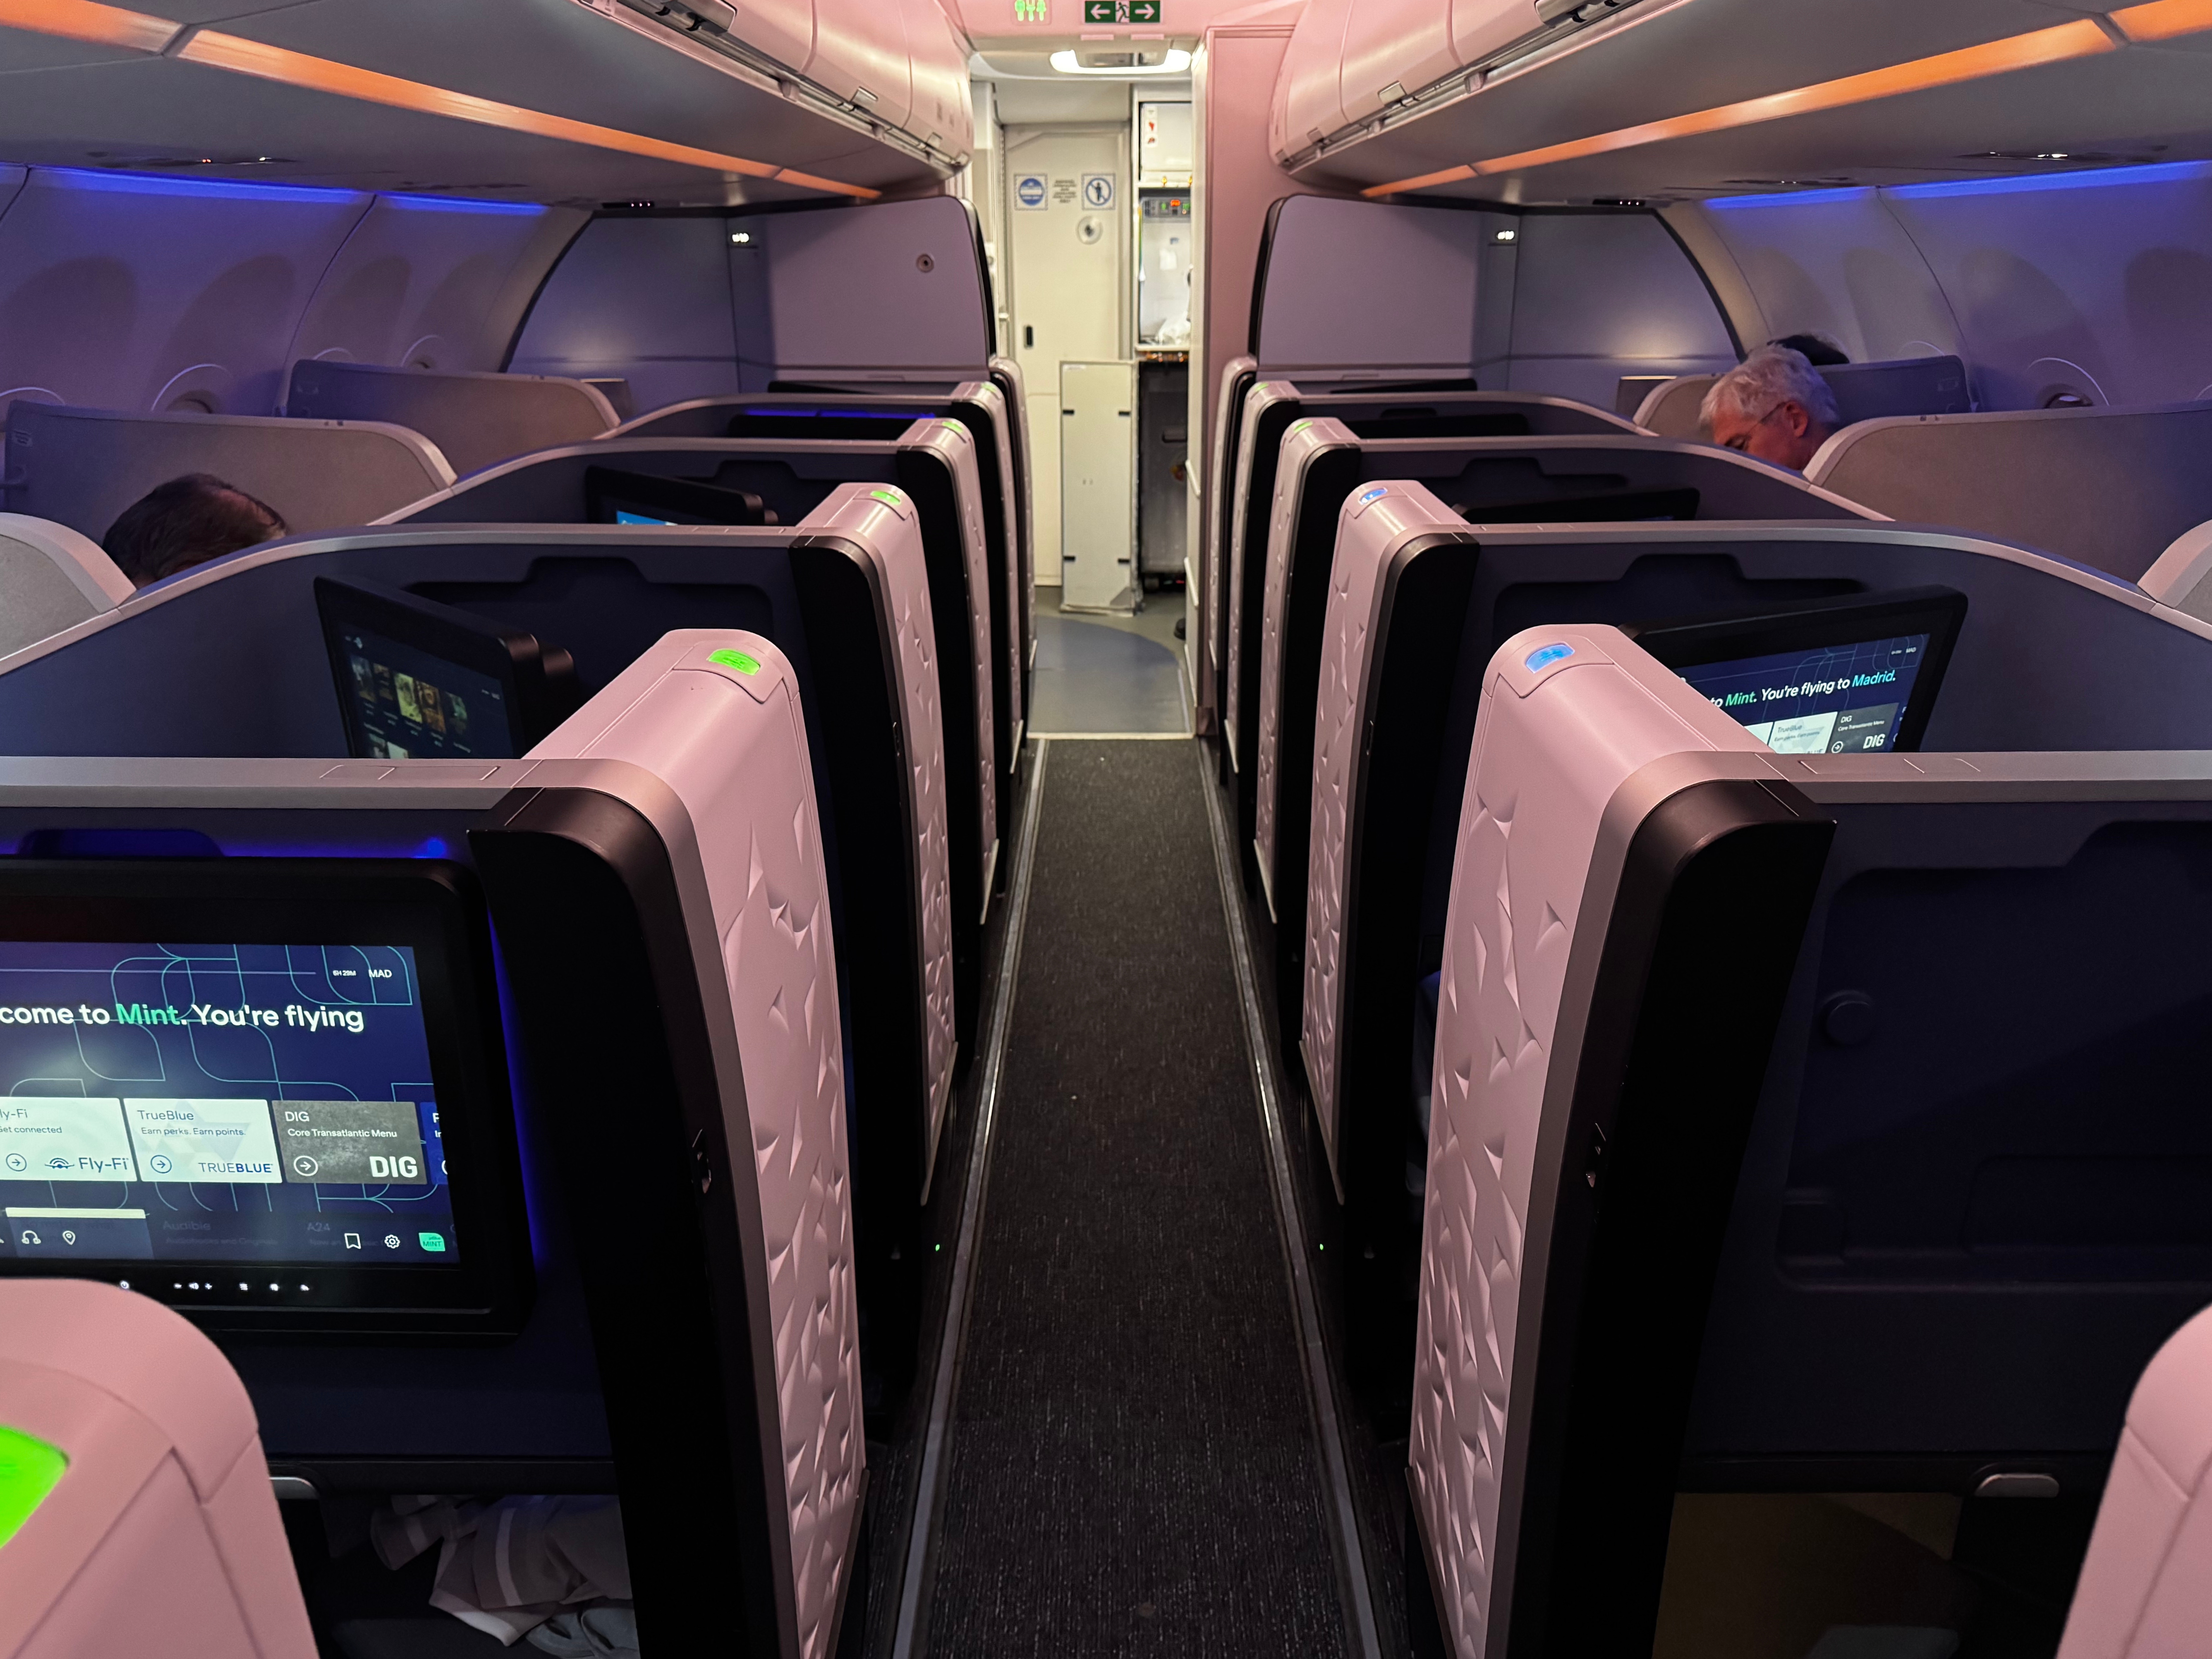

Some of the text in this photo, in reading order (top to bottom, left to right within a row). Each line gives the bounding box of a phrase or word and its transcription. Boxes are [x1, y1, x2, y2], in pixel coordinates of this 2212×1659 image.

[1710, 669, 1896, 708] to Mint. You're flying to Madrid.
[1841, 715, 1852, 723] DIG
[1863, 733, 1886, 749] DIG
[368, 969, 392, 978] MAD
[0, 1003, 364, 1033] come to Mint. You're flying
[137, 1110, 194, 1120] TrueBlue
[285, 1111, 310, 1122] DIG
[164, 1128, 192, 1136] perks.
[288, 1128, 398, 1138] Core Transatlantic Menu
[79, 1157, 127, 1173] Fly-Fi
[198, 1163, 273, 1173] TRUEBLUE
[369, 1156, 418, 1178] DIG
[163, 1220, 211, 1230] Audible
